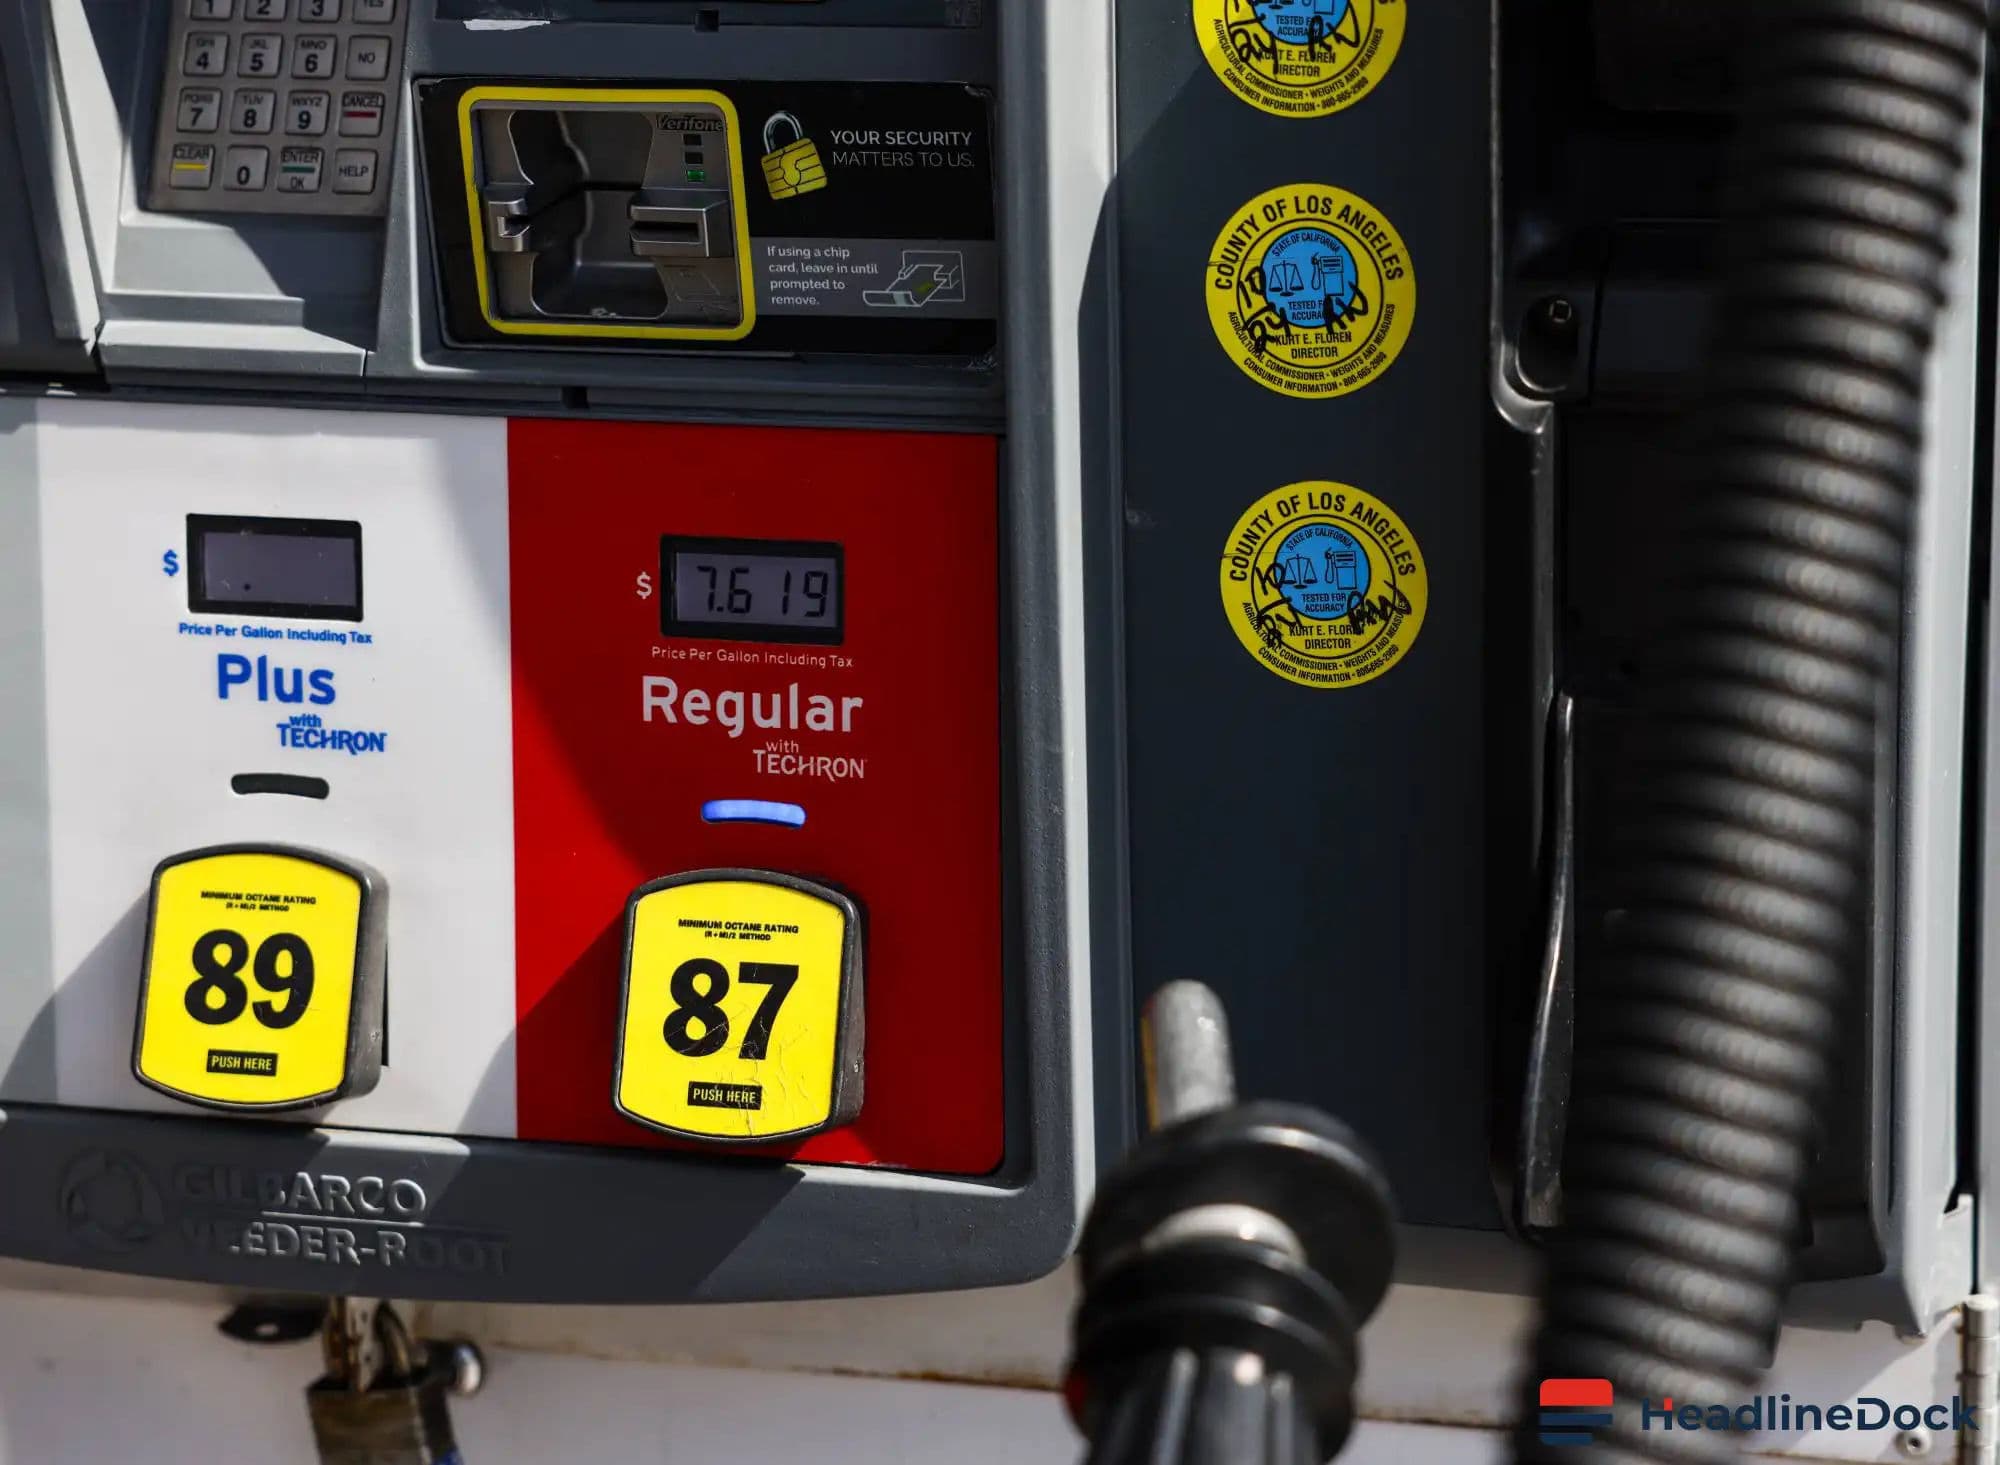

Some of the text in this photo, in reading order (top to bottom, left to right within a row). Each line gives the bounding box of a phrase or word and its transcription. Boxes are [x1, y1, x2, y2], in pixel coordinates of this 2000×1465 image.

[256, 0, 270, 15] 2
[311, 0, 323, 16] 3
[1276, 15, 1305, 25] TESTED
[196, 52, 210, 70] 4
[249, 53, 264, 71] 5
[305, 53, 318, 73] 6
[358, 52, 375, 64] NO
[1224, 68, 1261, 102] CONSUMER
[1261, 96, 1316, 113] INFORMATION
[1245, 72, 1303, 99] COMMISSIONER
[1310, 79, 1345, 98] WEIGHTS
[1344, 68, 1360, 82] AND
[242, 95, 264, 105] TUV
[292, 97, 323, 107] WXYZ
[342, 93, 382, 108] CANCEL
[190, 107, 204, 126] 7
[243, 109, 257, 128] 8
[297, 110, 311, 129] 9
[831, 131, 972, 146] YOUR SECURITY
[174, 146, 210, 160] CLEAR
[281, 150, 319, 163] ENTER
[833, 151, 975, 168] MATTERS TO US.
[236, 166, 250, 186] 0
[338, 166, 369, 178] HELP
[290, 176, 305, 190] OK
[1215, 195, 1404, 290] COUNTY OF LOS ANGELES
[1272, 232, 1340, 257] STATE OF CALIFORNIA
[767, 246, 850, 259] If using a chip
[769, 262, 878, 275] card, leave in until
[770, 279, 846, 291] prompted to
[771, 296, 820, 305] remove.
[1288, 301, 1316, 310] TESTED
[1265, 360, 1325, 380] COMMISSIONER
[1330, 356, 1364, 377] WEIGHTS
[1362, 344, 1377, 359] AND
[1374, 304, 1395, 346] MEASURES
[1315, 332, 1352, 344] FLOREN
[1291, 347, 1338, 359] DIRECTOR
[1244, 357, 1283, 387] CONSUMER
[1284, 380, 1338, 393] INFORMATION
[1230, 492, 1416, 582] COUNTY OF LOS ANGELES
[1286, 528, 1354, 551] STATE OF CALIFORNIA
[163, 549, 179, 577] $
[636, 571, 652, 600] $
[697, 565, 829, 618] 7.619
[1301, 593, 1346, 602] TESTED FOR
[1305, 603, 1345, 612] ACCURACY
[179, 622, 372, 645] Price Per Gallon Including Tax
[1305, 638, 1351, 649] DIRECTOR
[651, 646, 853, 668] Price Per Gallon Including Tax
[1280, 649, 1338, 670] COMMISSIONER
[1344, 648, 1376, 668] WEIGHTS
[1375, 637, 1390, 652] AND
[1258, 647, 1297, 676] CONSUMER
[1298, 670, 1351, 683] INFORMATION
[217, 653, 336, 705] Plus
[642, 675, 864, 738] Regular
[289, 714, 322, 728] with
[276, 723, 387, 755] TECHRON
[766, 739, 799, 753] with
[752, 750, 865, 782] TECHRON
[201, 891, 317, 905] MINIMUM OCTANE RATING
[678, 918, 799, 934] MINIMUM OCTANE RATING
[739, 933, 771, 941] METHOD
[184, 928, 315, 1029] 89
[662, 958, 799, 1060] 87
[211, 1055, 272, 1071] PUSH HERE
[693, 1087, 756, 1103] PUSH HERE
[175, 1165, 428, 1217] GILBARCO
